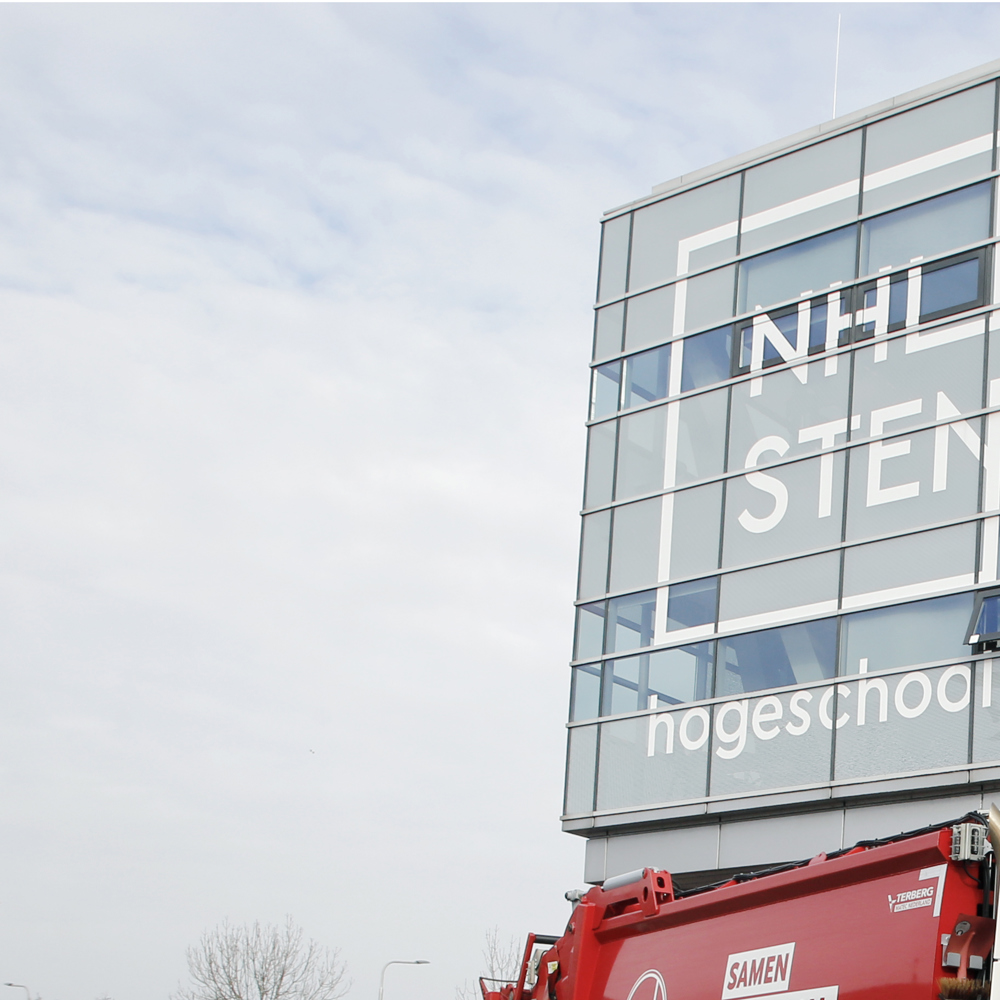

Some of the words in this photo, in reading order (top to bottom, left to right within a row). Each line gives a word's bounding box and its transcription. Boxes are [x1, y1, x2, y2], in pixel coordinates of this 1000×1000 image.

[749, 255, 980, 398] NHL
[647, 650, 994, 760] hogeschool
[896, 886, 934, 903] TERBERG
[726, 953, 790, 990] SAMEN
